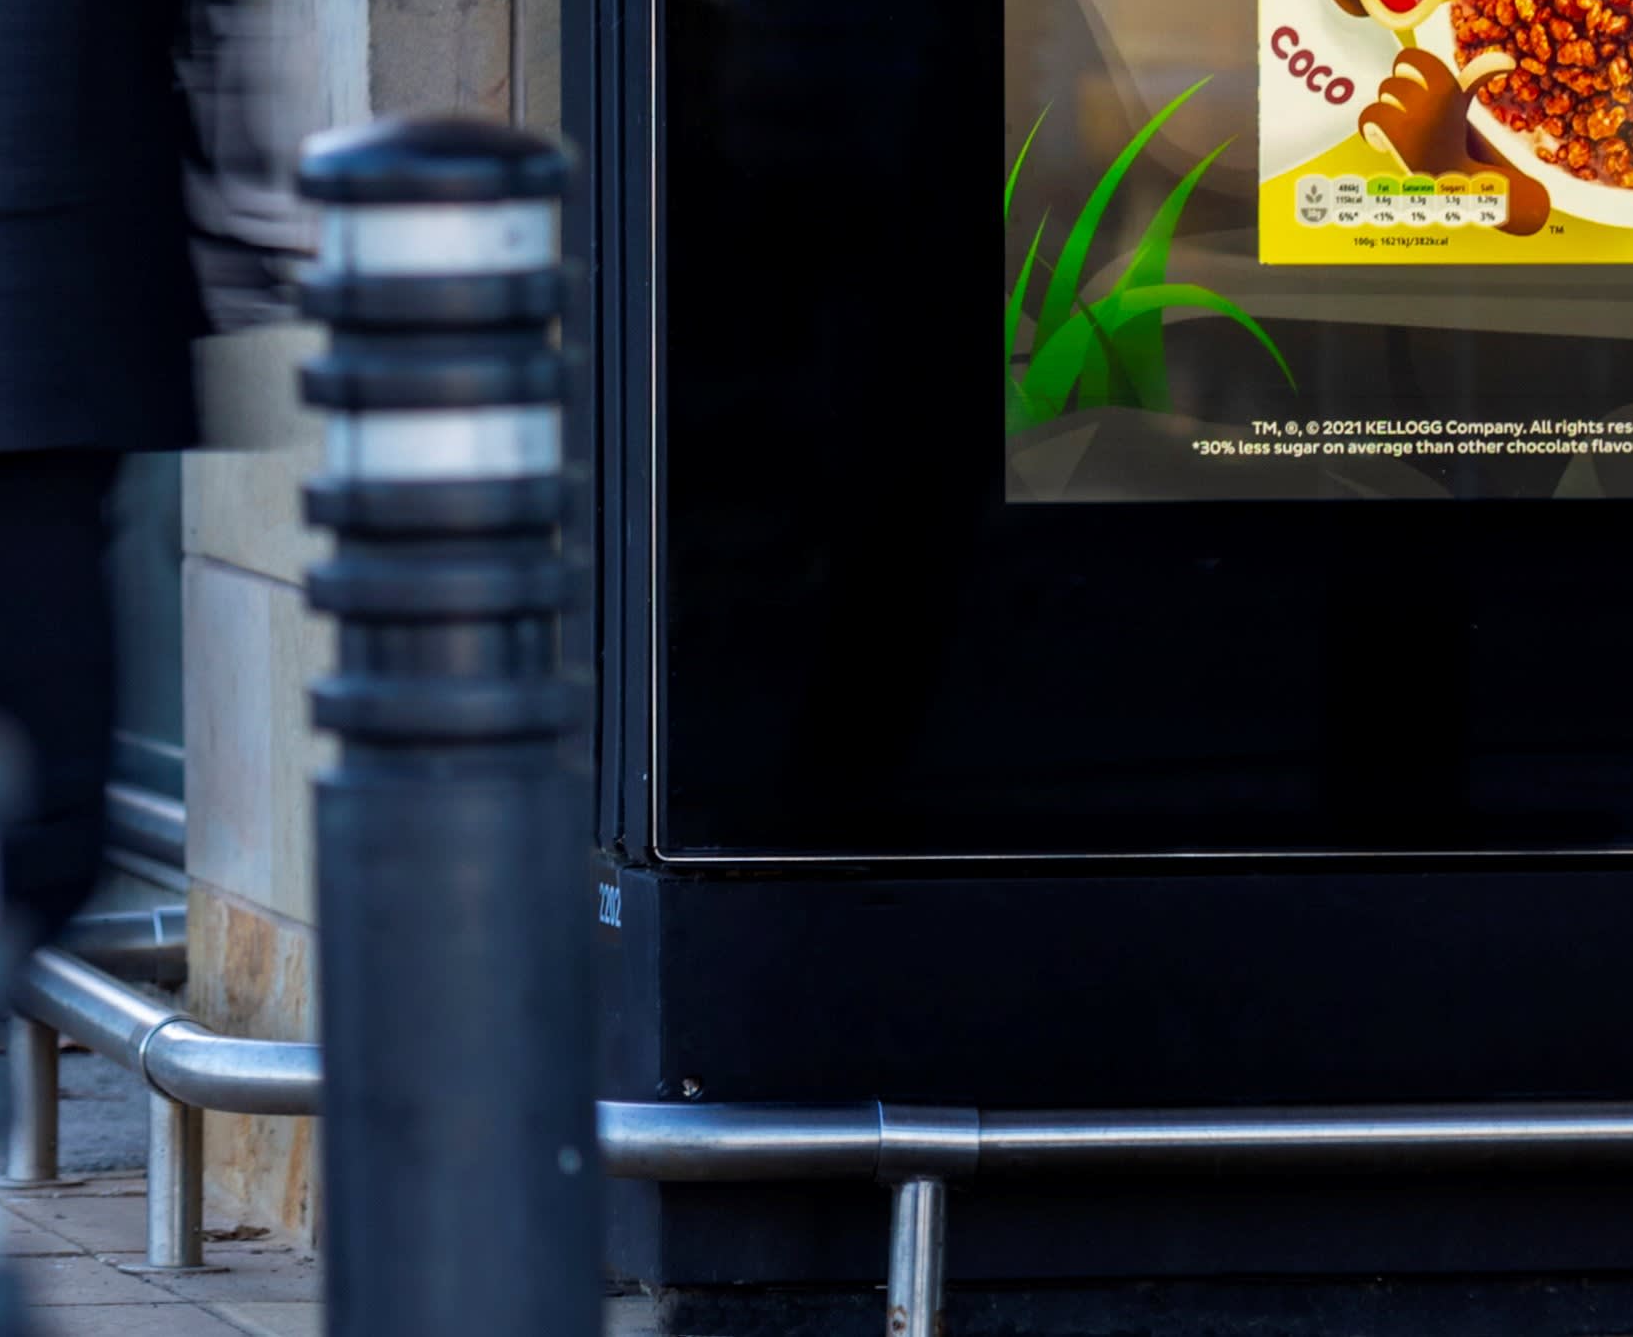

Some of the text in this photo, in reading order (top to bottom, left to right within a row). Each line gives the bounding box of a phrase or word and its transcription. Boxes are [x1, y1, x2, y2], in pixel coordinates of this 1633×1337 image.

[1440, 184, 1465, 193] Sugars
[1411, 212, 1426, 221] 1%
[1445, 212, 1461, 221] 6%
[1323, 421, 1361, 434] 2021
[1366, 420, 1442, 434] KELLOGG
[1446, 420, 1526, 437] Company.
[1530, 420, 1552, 434] All
[1555, 420, 1604, 437] rights
[1239, 440, 1270, 454] less
[1274, 442, 1319, 457] sugar
[1324, 443, 1345, 454] on
[1348, 442, 1412, 456] average
[1416, 440, 1454, 454] than
[1458, 440, 1504, 454] other
[1507, 439, 1588, 453] chocolate
